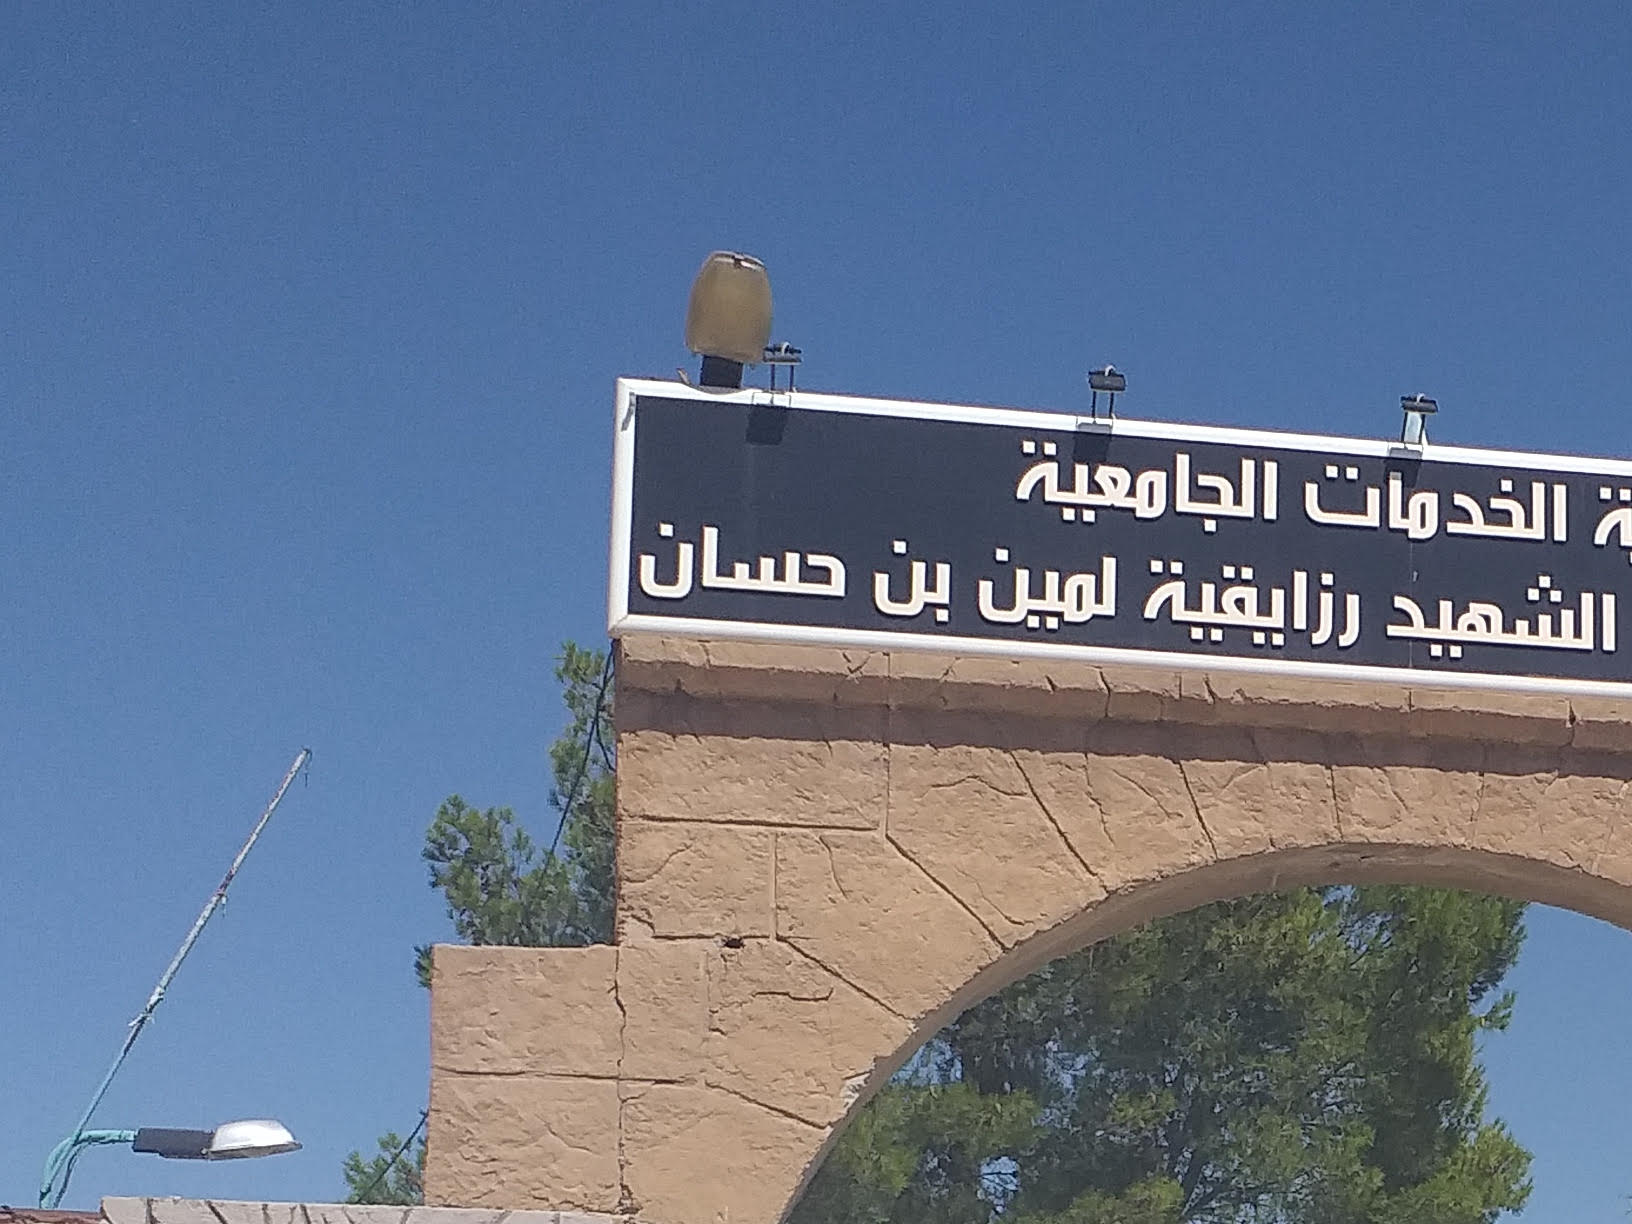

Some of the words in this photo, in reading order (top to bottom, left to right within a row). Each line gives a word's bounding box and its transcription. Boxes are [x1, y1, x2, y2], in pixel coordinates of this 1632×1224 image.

[1015, 439, 1279, 533] الجامعية
[1304, 464, 1568, 543] الخدمات
[638, 522, 847, 600] حسان
[873, 539, 952, 623] بن
[977, 547, 1118, 631] لمين
[1142, 558, 1361, 647] رزايقية
[1385, 574, 1617, 658] الشهيد
